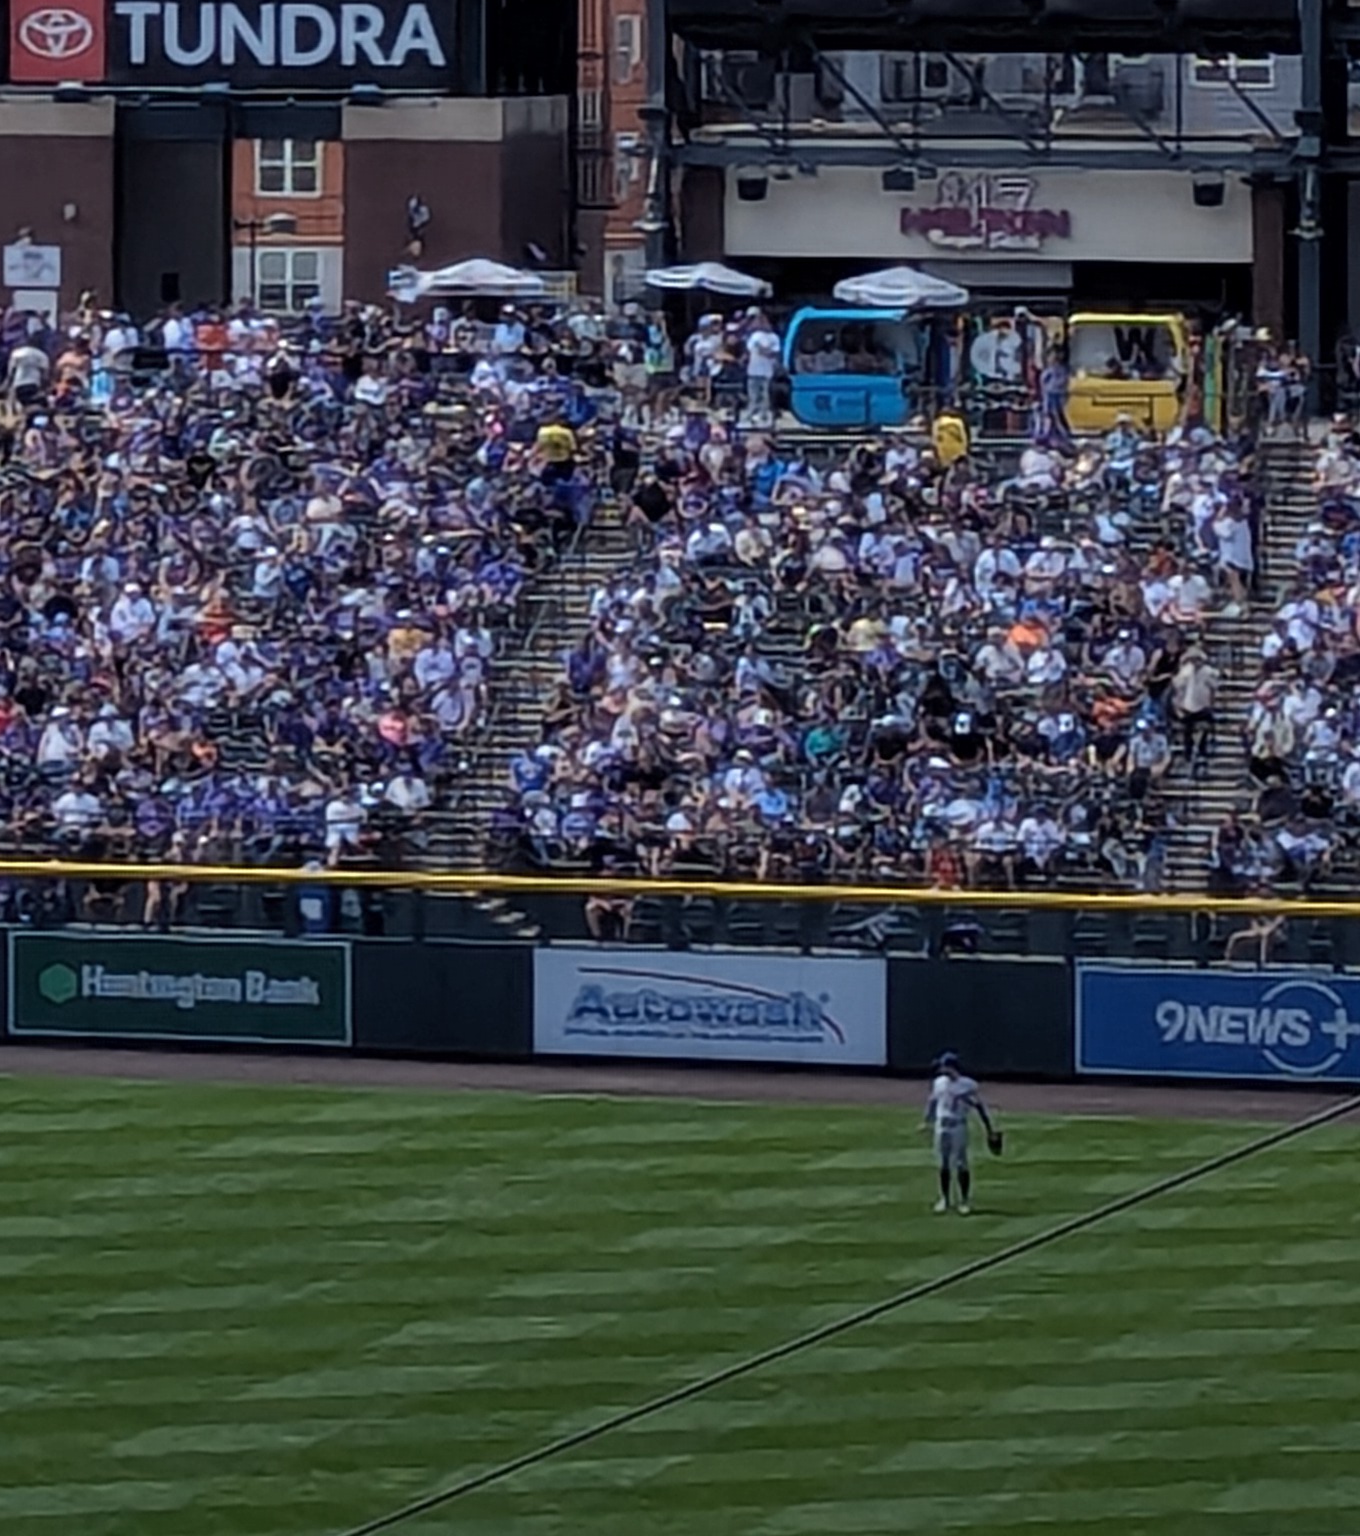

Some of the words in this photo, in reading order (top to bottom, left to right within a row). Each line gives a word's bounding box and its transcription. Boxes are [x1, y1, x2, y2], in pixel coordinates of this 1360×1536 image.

[115, 2, 446, 66] TUNDRA
[81, 965, 242, 1008] Huntington
[245, 970, 320, 1005] Bank
